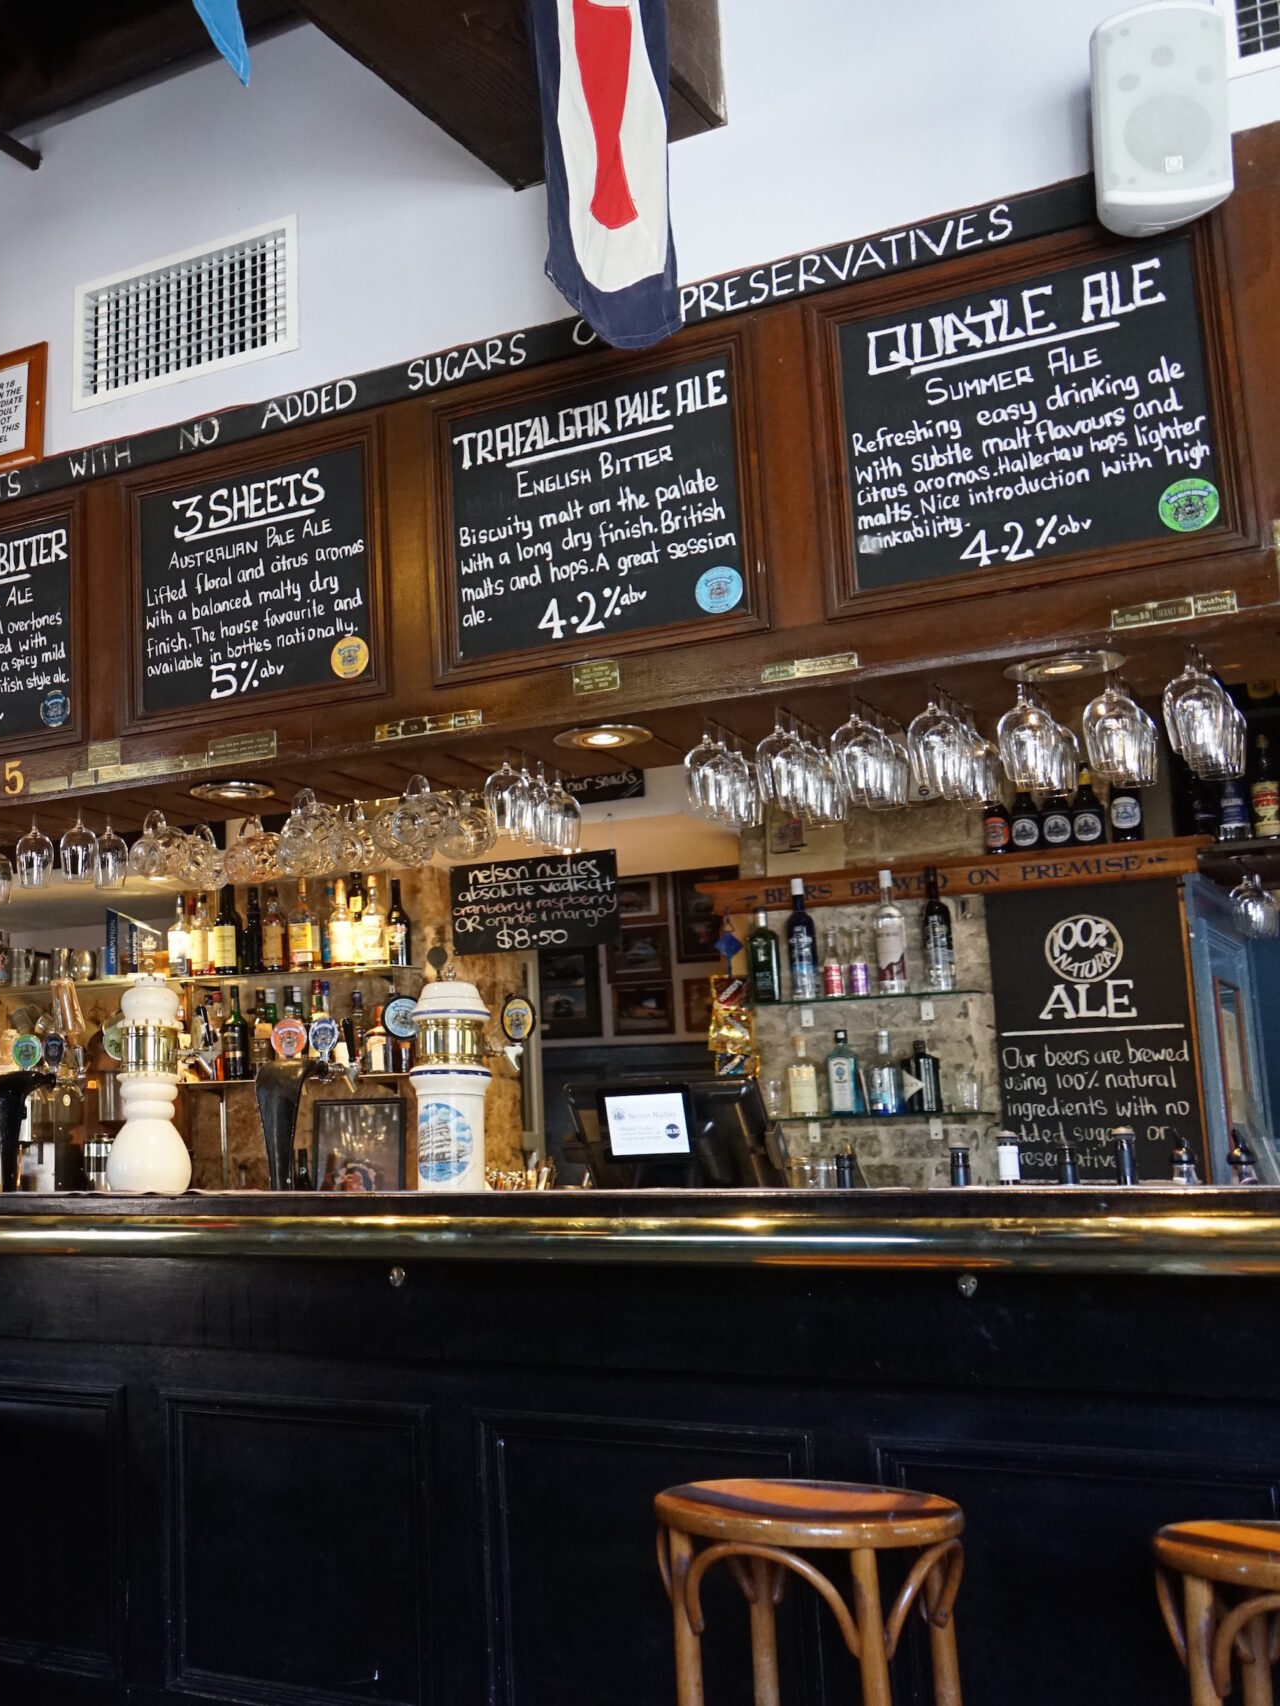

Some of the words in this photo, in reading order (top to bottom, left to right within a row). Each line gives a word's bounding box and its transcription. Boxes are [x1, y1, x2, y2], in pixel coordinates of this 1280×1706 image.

[679, 204, 1013, 322] PRESERVATIVES
[1082, 258, 1166, 322] ALE
[408, 333, 527, 390] SUGARS
[925, 366, 1035, 406] SUMMER
[1047, 346, 1102, 376] ALE
[6, 379, 15, 389] 18
[6, 386, 22, 398] THE
[178, 417, 219, 451] NO
[261, 379, 356, 429] ADDED
[453, 400, 611, 470] TRAFALGAR
[615, 385, 671, 431] PALE
[676, 369, 728, 416] ALE
[852, 419, 963, 457] Refreshing
[977, 400, 1038, 427] easy
[1046, 374, 1140, 411] drinking
[1147, 355, 1185, 384] ale
[1, 422, 20, 434] THIS
[68, 443, 132, 479] WITH
[516, 468, 592, 498] ENGLISH
[599, 445, 673, 480] BITTER
[172, 495, 204, 539] 3
[208, 467, 326, 529] SHEETS
[459, 515, 534, 548] Biscuity
[539, 499, 584, 528] malt
[589, 499, 611, 515] on
[617, 486, 649, 512] the
[654, 468, 719, 510] palate
[1057, 515, 1093, 536] abv
[168, 540, 258, 571] AUSTRALIAN
[267, 525, 296, 549] PALE
[302, 519, 332, 539] ALE
[147, 578, 187, 607] Lifted
[196, 566, 232, 595] floral
[237, 558, 265, 583] and
[271, 552, 308, 573] citrus
[315, 539, 365, 562] aromas
[6, 586, 34, 607] ALE
[620, 584, 647, 606] abv
[8, 611, 62, 634] overtones
[210, 659, 259, 700] 5%
[260, 660, 285, 679] abv
[469, 864, 529, 885] nelson
[536, 856, 600, 881] nudies
[764, 883, 833, 905] BERS
[967, 867, 1012, 887] ON
[1019, 854, 1143, 882] PREMISE
[458, 880, 537, 902] absolute
[536, 893, 618, 914] raspberry
[455, 915, 484, 933] OR
[485, 911, 537, 930] orange
[552, 907, 609, 928] mango
[1052, 917, 1110, 956] 100%
[1054, 941, 1120, 979] NATURAL
[1039, 979, 1138, 1020] ALE
[1002, 1047, 1038, 1069] Our
[1044, 1043, 1090, 1066] beers
[1093, 1048, 1124, 1064] are
[1126, 1038, 1190, 1064] brewed
[1004, 1072, 1048, 1096] using
[1057, 1069, 1100, 1090] 100%
[1104, 1065, 1177, 1089] natural
[1007, 1095, 1108, 1122] ingredients
[1116, 1095, 1158, 1118] with
[1165, 1100, 1190, 1117] no
